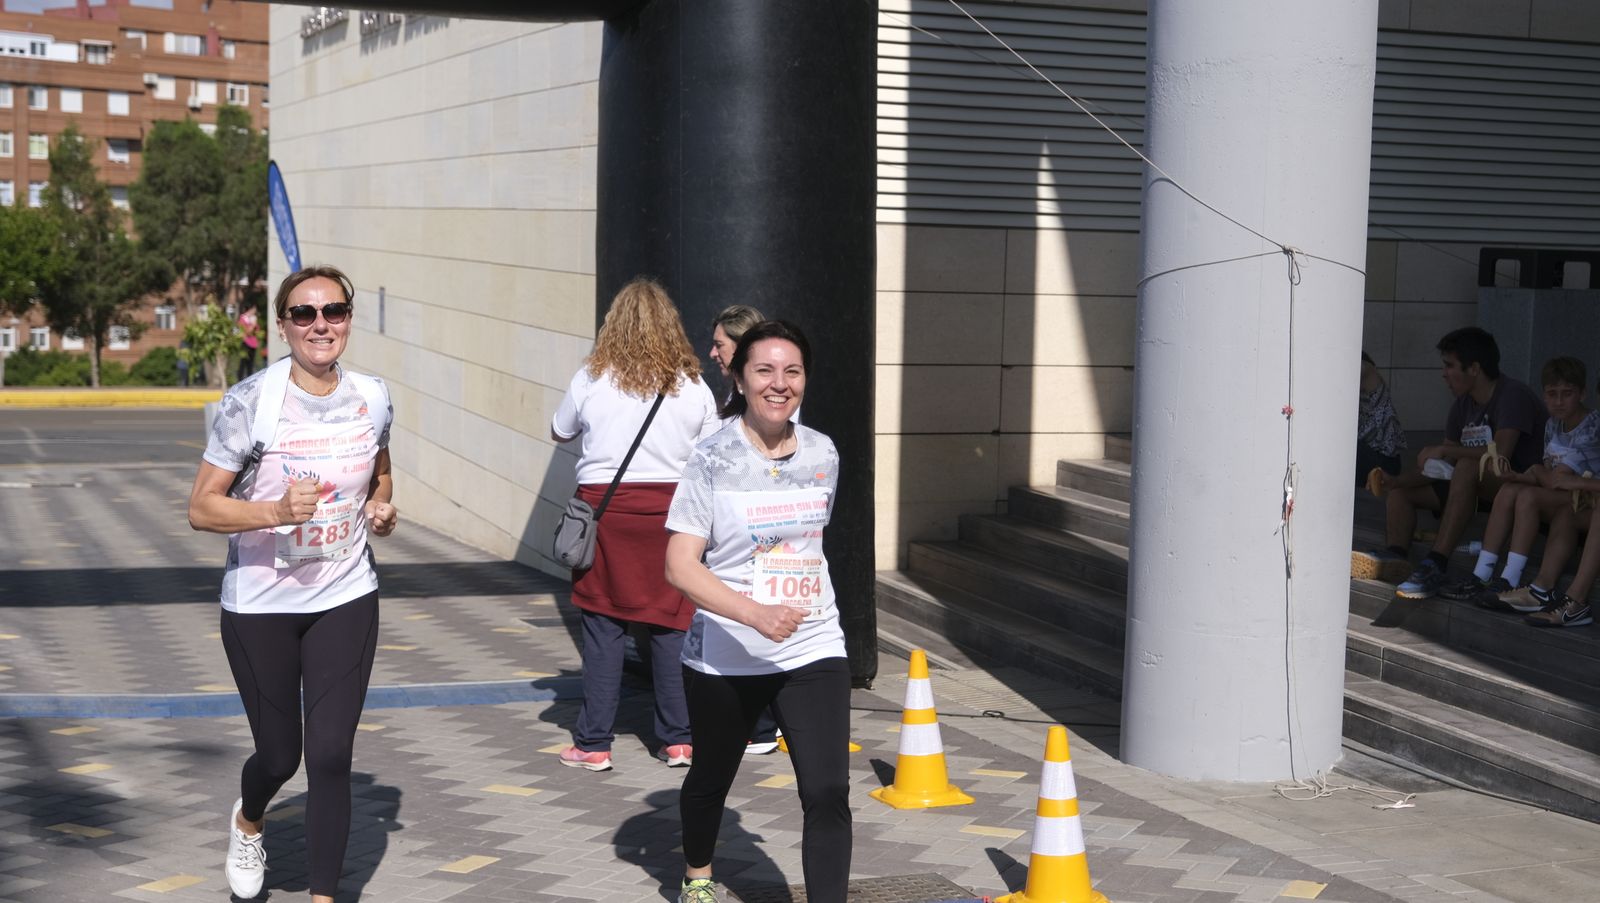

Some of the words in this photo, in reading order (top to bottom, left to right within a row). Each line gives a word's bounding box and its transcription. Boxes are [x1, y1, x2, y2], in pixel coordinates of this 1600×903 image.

[288, 438, 330, 450] CARRERA
[755, 503, 796, 516] CARRERA
[796, 501, 812, 512] SIN
[290, 520, 350, 547] 1283
[770, 558, 801, 566] CARRERA
[765, 575, 821, 598] 1064
